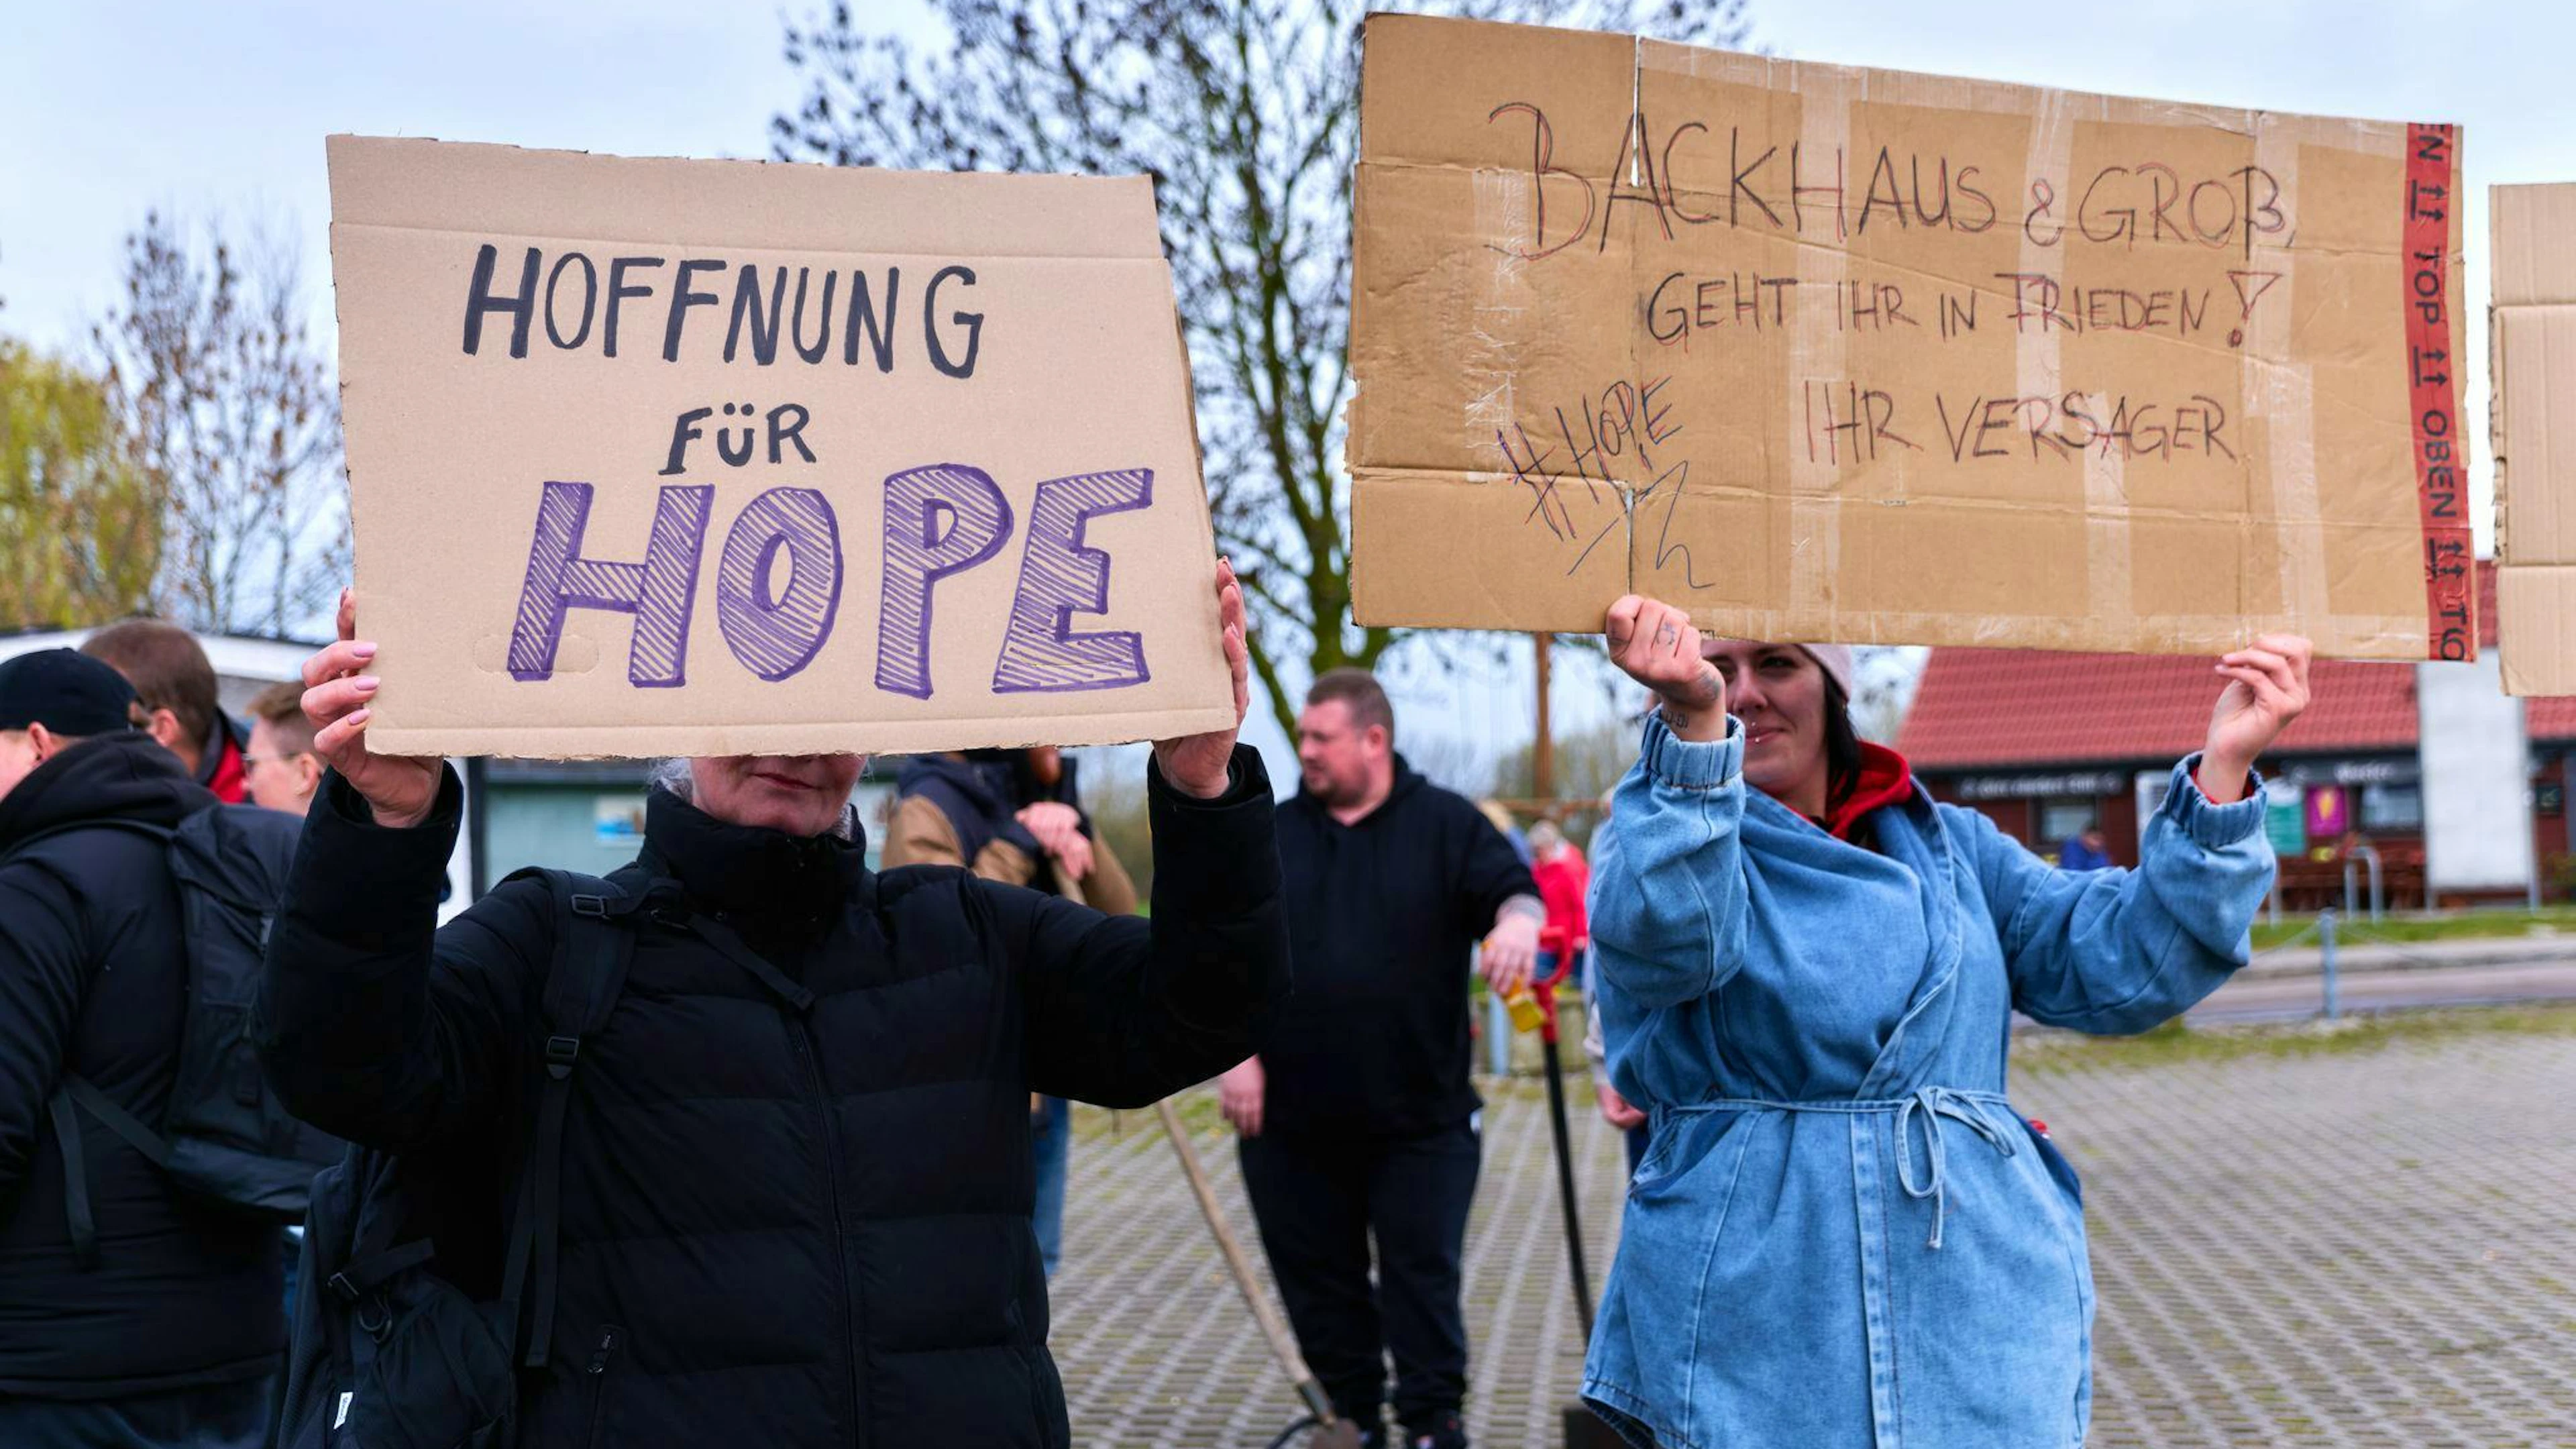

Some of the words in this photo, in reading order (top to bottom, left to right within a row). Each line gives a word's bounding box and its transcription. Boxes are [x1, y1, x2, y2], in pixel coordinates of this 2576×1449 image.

[1483, 101, 1996, 262] BACKHAUS
[2025, 178, 2064, 247] &
[462, 244, 985, 379] HOFFNUNG
[1646, 271, 1799, 348] GEHT
[1837, 279, 1921, 332] IHR
[1939, 288, 1976, 343] IN
[2414, 246, 2440, 325] TOP
[657, 402, 817, 476] FÜR
[1804, 380, 1925, 466] IHR
[1935, 390, 2238, 464] VERSAGER
[2422, 409, 2458, 517] OBEN
[506, 463, 1155, 700] HOPE
